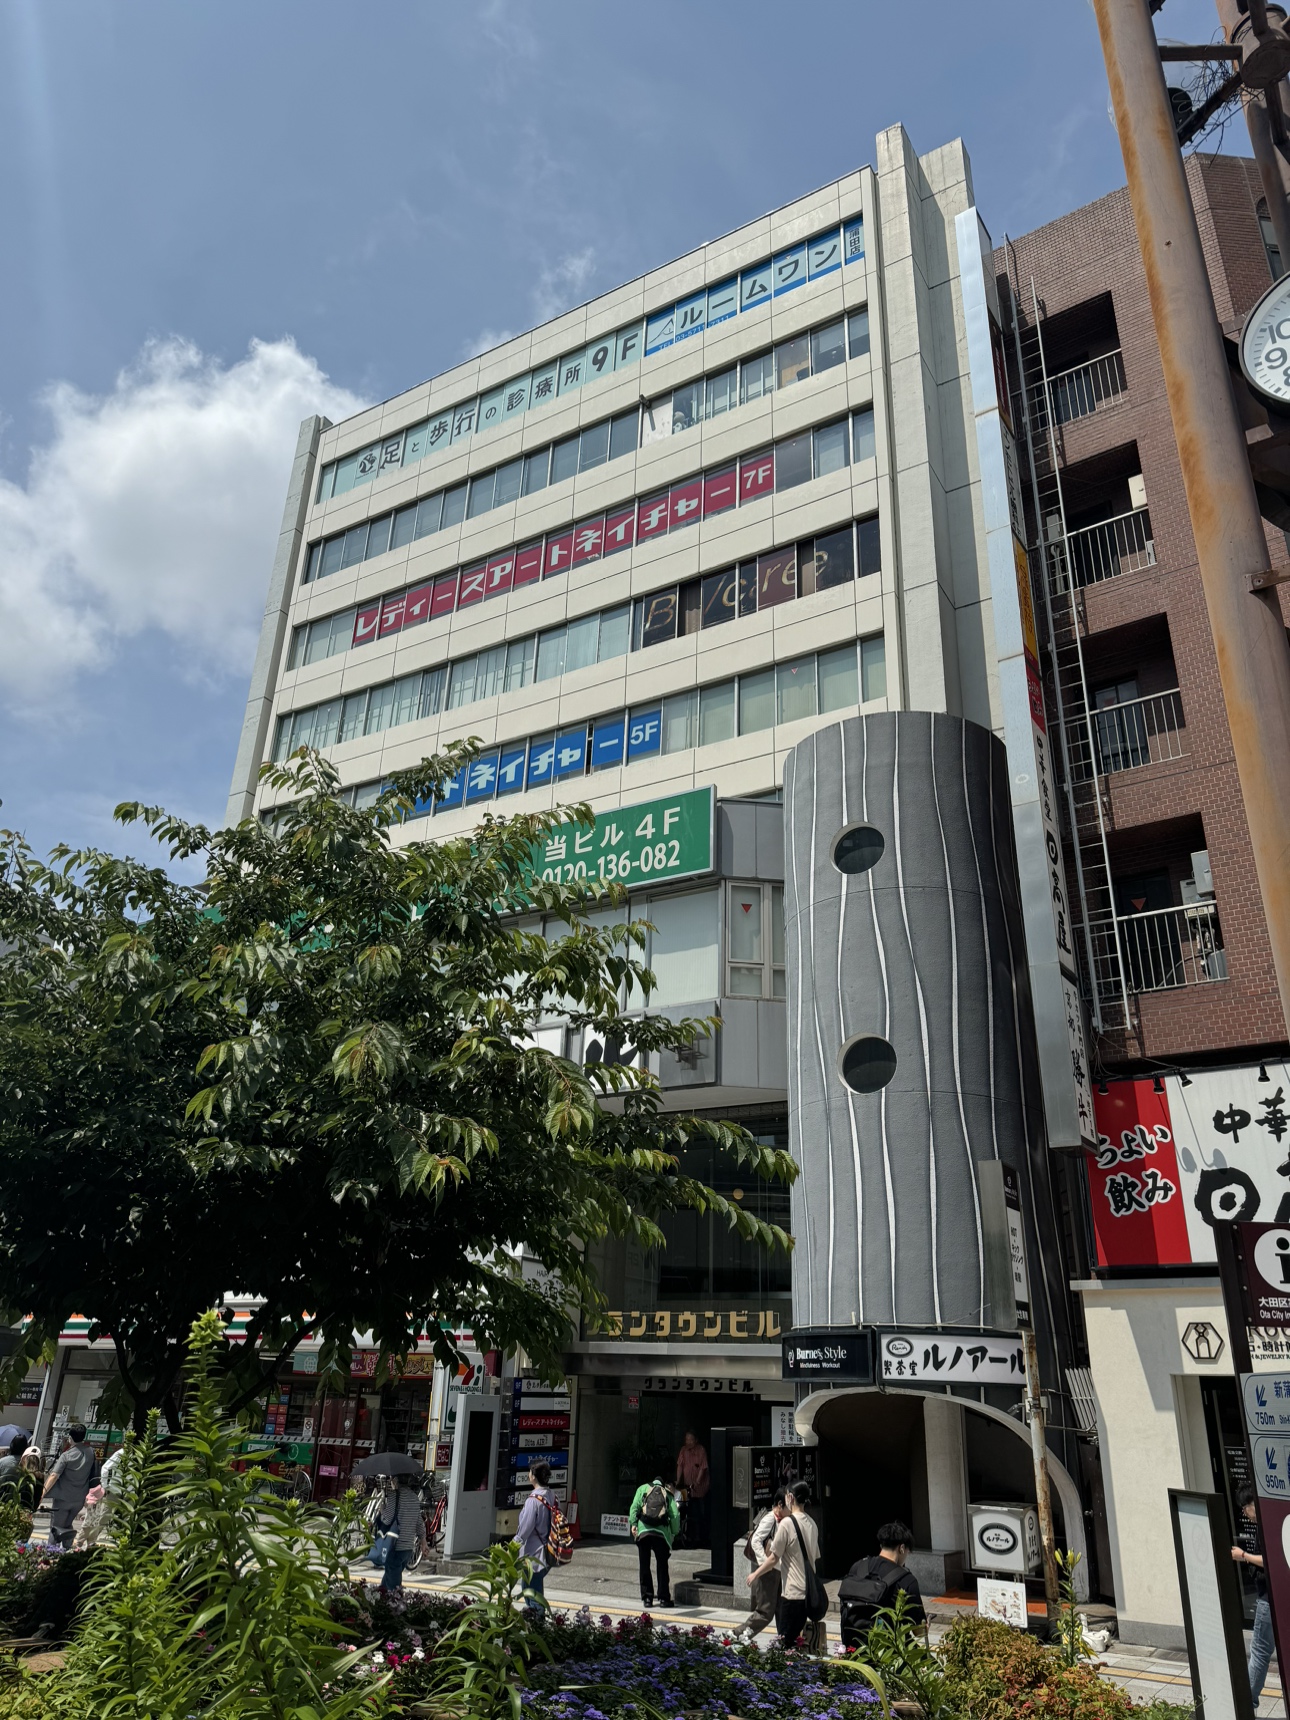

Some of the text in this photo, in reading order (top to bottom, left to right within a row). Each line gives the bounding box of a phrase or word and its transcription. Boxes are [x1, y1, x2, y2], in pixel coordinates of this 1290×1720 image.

[680, 244, 837, 328] ルームワン
[1265, 347, 1287, 370] 9
[356, 463, 771, 643] レディースアートネイチャー 7F
[629, 720, 659, 746] 5F
[544, 806, 681, 863] 当ビル 4F
[1212, 1086, 1290, 1143] 中華
[1097, 1125, 1171, 1168] ちょい
[1105, 1168, 1176, 1217] 飲み
[1258, 1296, 1290, 1308] 大田区
[1260, 1309, 1271, 1319] Ota
[1271, 1310, 1284, 1321] City
[824, 1345, 847, 1359] Style
[922, 1343, 1028, 1374] ルノアール
[1260, 1353, 1285, 1361] JEWELRY
[884, 1359, 918, 1376] 喫茶室
[644, 1378, 754, 1393] グランタウンビル
[1255, 1412, 1276, 1425] 750m
[1265, 1474, 1286, 1490] 950m
